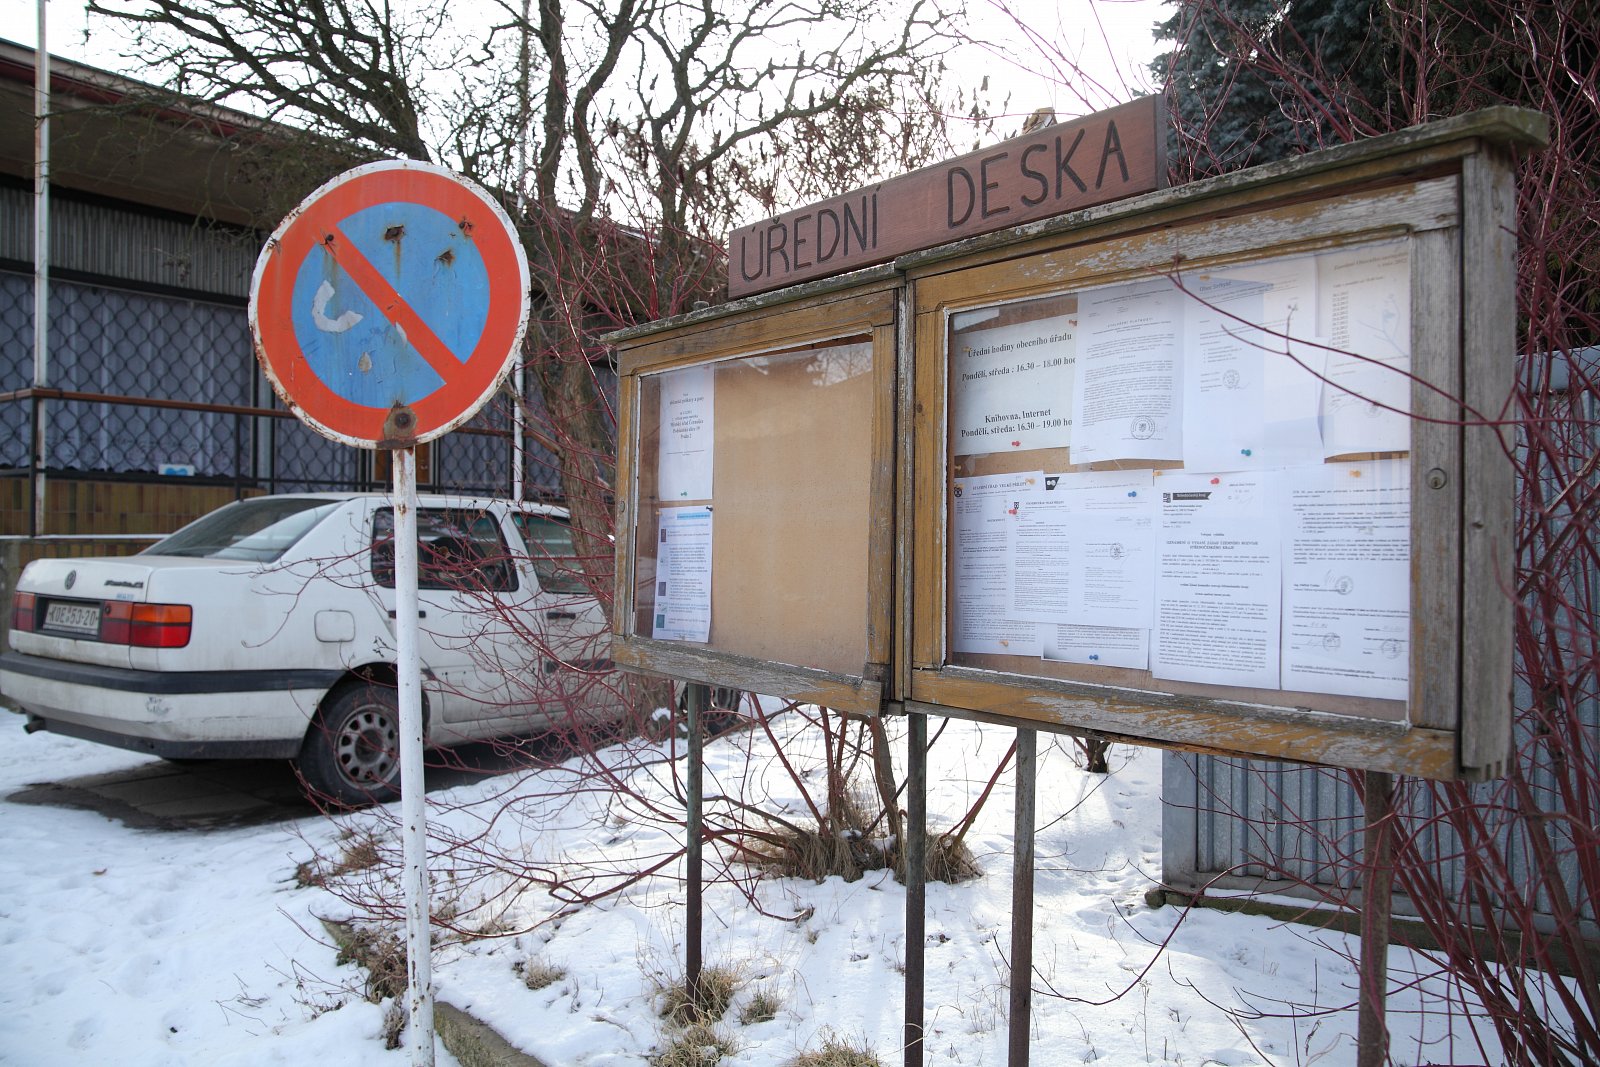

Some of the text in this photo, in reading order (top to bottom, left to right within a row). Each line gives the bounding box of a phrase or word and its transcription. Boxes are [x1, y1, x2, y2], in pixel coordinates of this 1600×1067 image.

[741, 119, 1130, 282] ÚŘEDNÍ DESKA
[991, 343, 1014, 354] hodiny
[1016, 336, 1048, 349] obecního
[1049, 332, 1072, 343] úřadu
[988, 365, 1010, 377] středa
[1016, 361, 1035, 373] 16.30
[985, 408, 1051, 424] Knihovna, Internet
[990, 423, 1015, 435] středa:
[1016, 421, 1035, 432] 16.30
[1042, 418, 1062, 429] 19.00
